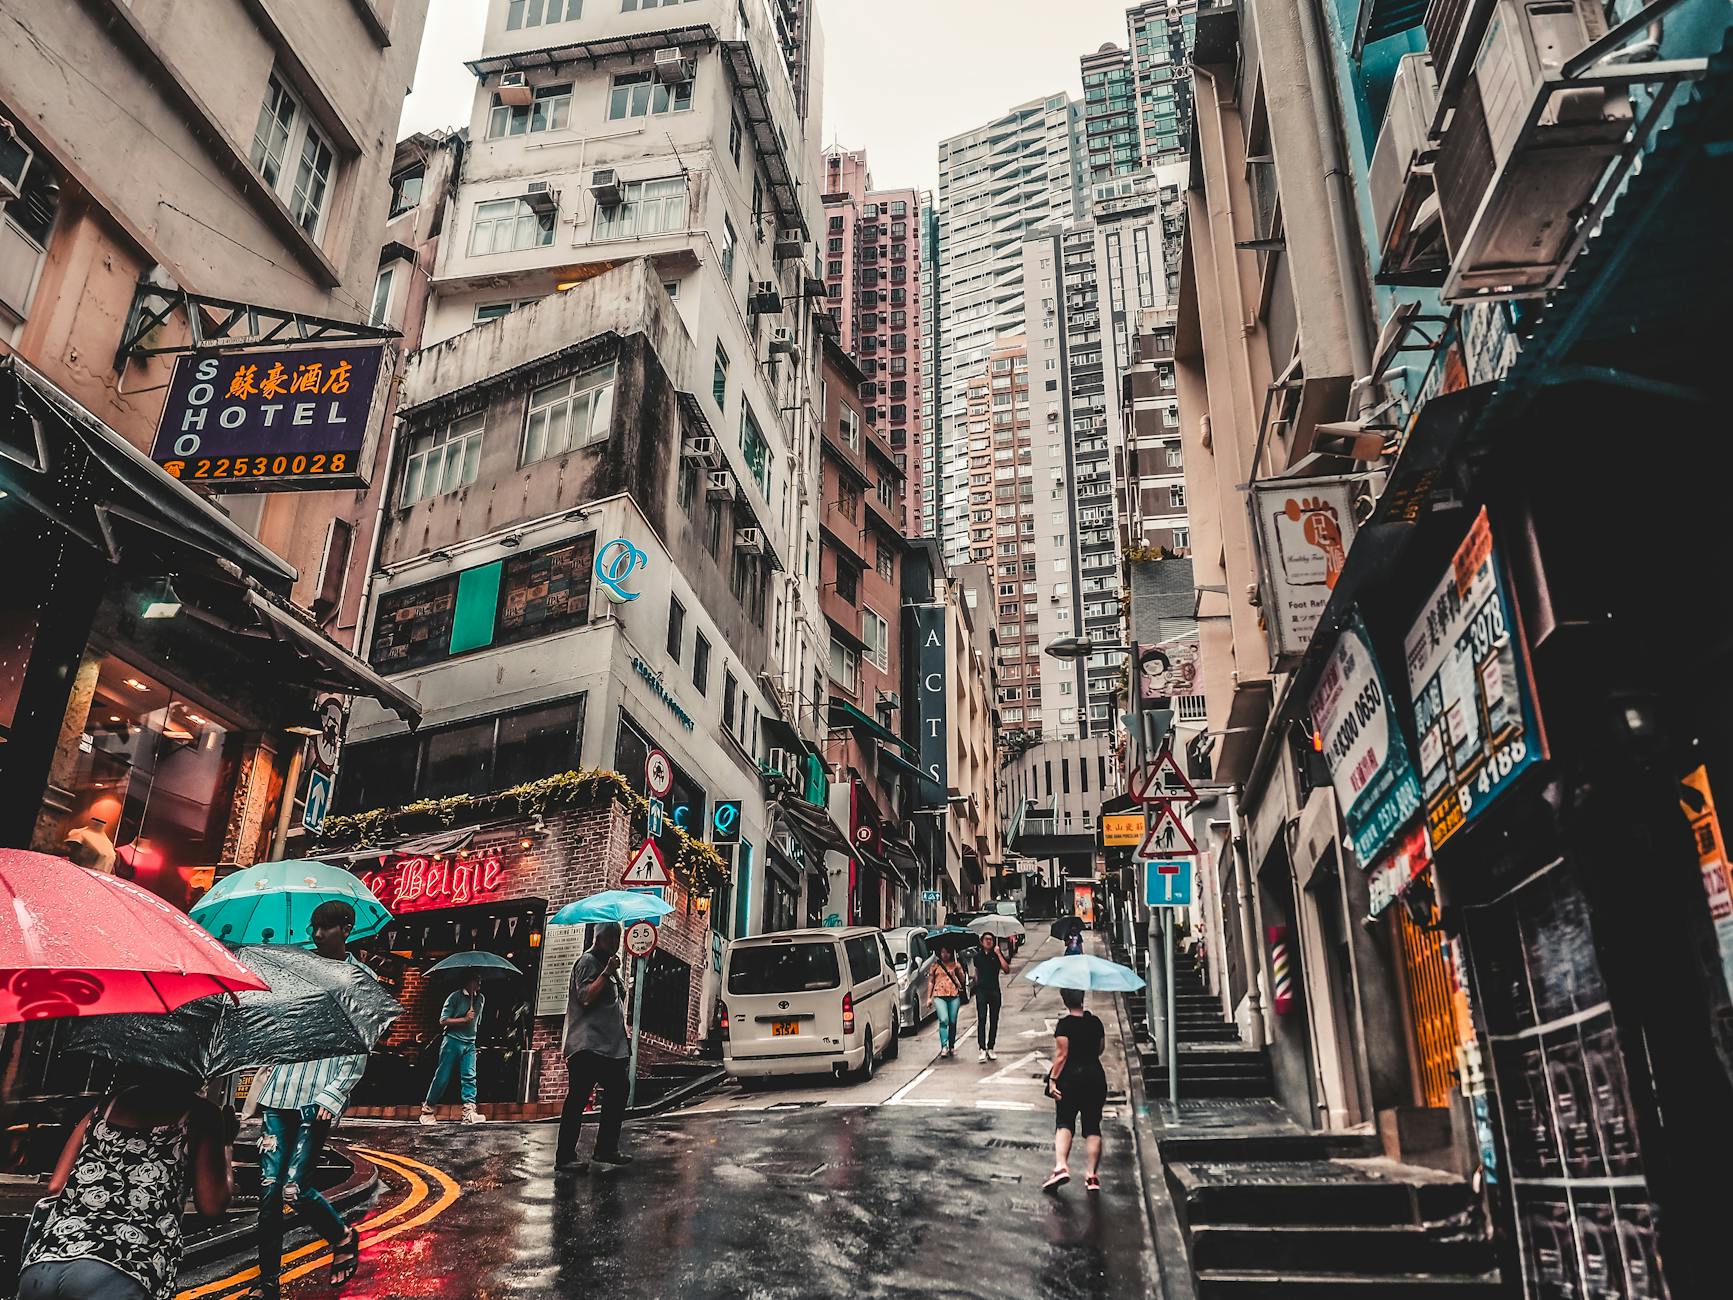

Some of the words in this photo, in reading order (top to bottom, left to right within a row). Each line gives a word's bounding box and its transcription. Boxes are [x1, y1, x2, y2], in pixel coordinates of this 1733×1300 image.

[225, 360, 353, 401] 蘇豪酒店
[173, 358, 219, 457] SOHO
[194, 453, 346, 479] 22530028
[1288, 600, 1307, 609] Foot
[924, 628, 942, 783] ACTS
[391, 857, 498, 910] Belgie
[174, 914, 248, 974] PACIFIC
[632, 928, 650, 939] 5.5
